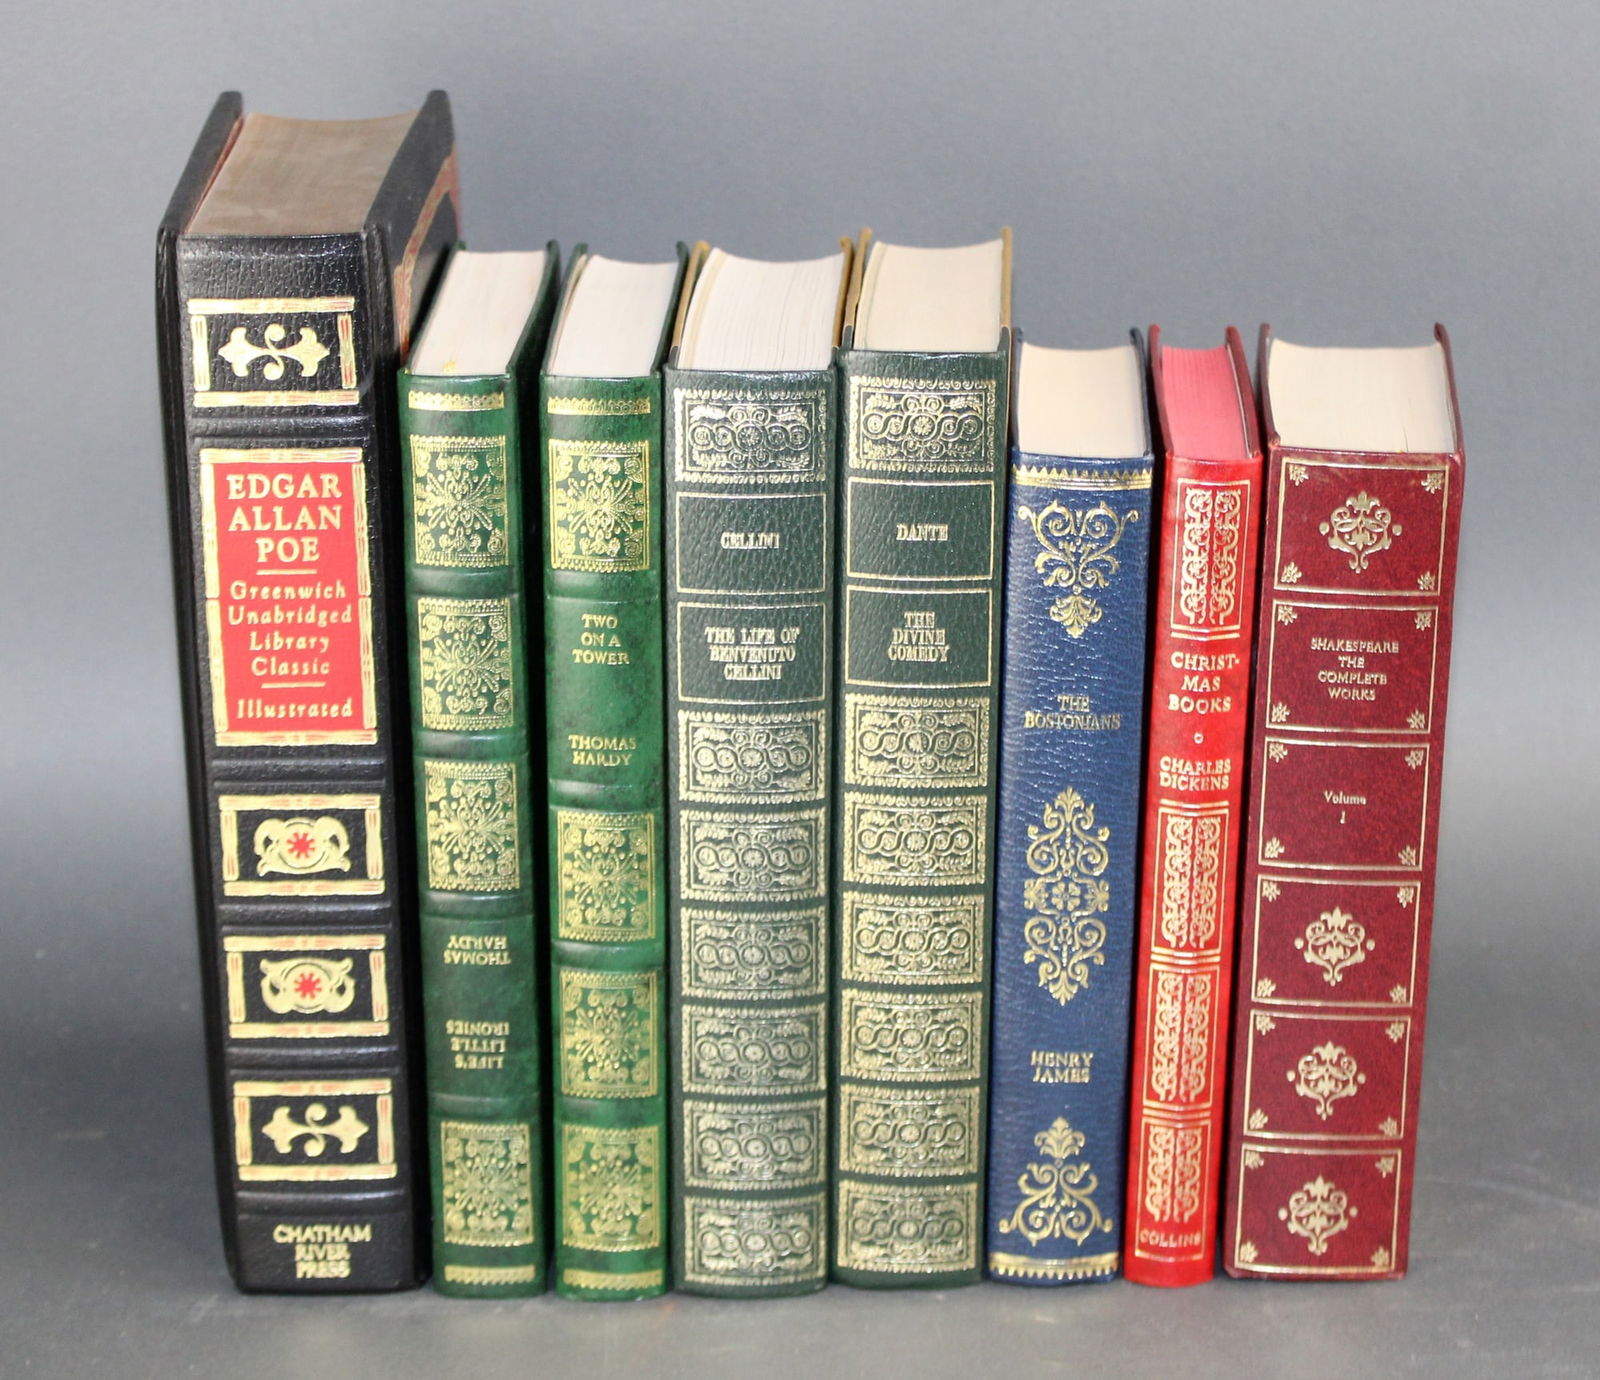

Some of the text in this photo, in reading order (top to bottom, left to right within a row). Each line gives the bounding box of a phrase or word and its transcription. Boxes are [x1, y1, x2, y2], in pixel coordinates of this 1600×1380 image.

[226, 473, 342, 500] EDGAR
[227, 505, 342, 532] ALLAN
[720, 532, 780, 549] CELLINI
[896, 523, 948, 541] DANTE
[256, 537, 320, 563] POE
[229, 580, 346, 601] Greenwich
[227, 604, 352, 628] Unabridged
[581, 613, 618, 629] TWO
[903, 611, 936, 628] THE
[249, 631, 329, 653] Library
[580, 632, 621, 647] ON A
[704, 627, 800, 645] THE LIFE OF
[892, 628, 946, 646] DIVINE
[1311, 637, 1400, 653] SHAKESPEARE
[571, 649, 630, 665] TOWER
[709, 645, 796, 662] BENVENUTO
[887, 645, 950, 662] COMEDY
[1338, 655, 1365, 668] THE
[251, 656, 330, 676] Classic
[723, 664, 782, 680] CELLINI
[1181, 675, 1222, 692] MAS
[1317, 671, 1388, 685] COMPLETE
[1328, 687, 1376, 700] WORKS
[236, 698, 353, 719] Illustrated
[1057, 694, 1090, 712] THE
[1168, 694, 1232, 714] BOOKS
[1024, 710, 1122, 730] BOSTONIANS
[568, 734, 637, 750] THOMAS
[572, 751, 632, 766] HARDY
[1160, 755, 1232, 776] CHARLES
[1159, 771, 1230, 791] DICKENS
[1323, 790, 1367, 805] Volume
[447, 935, 508, 950] HARDY
[444, 949, 512, 965] THOMAS
[1030, 1050, 1094, 1068] HENRY
[1032, 1066, 1091, 1084] JAMES
[273, 1224, 372, 1243] CHATHAM
[1139, 1229, 1202, 1248] COLLINS
[294, 1243, 352, 1261] RIVER
[296, 1260, 350, 1279] PRESS
